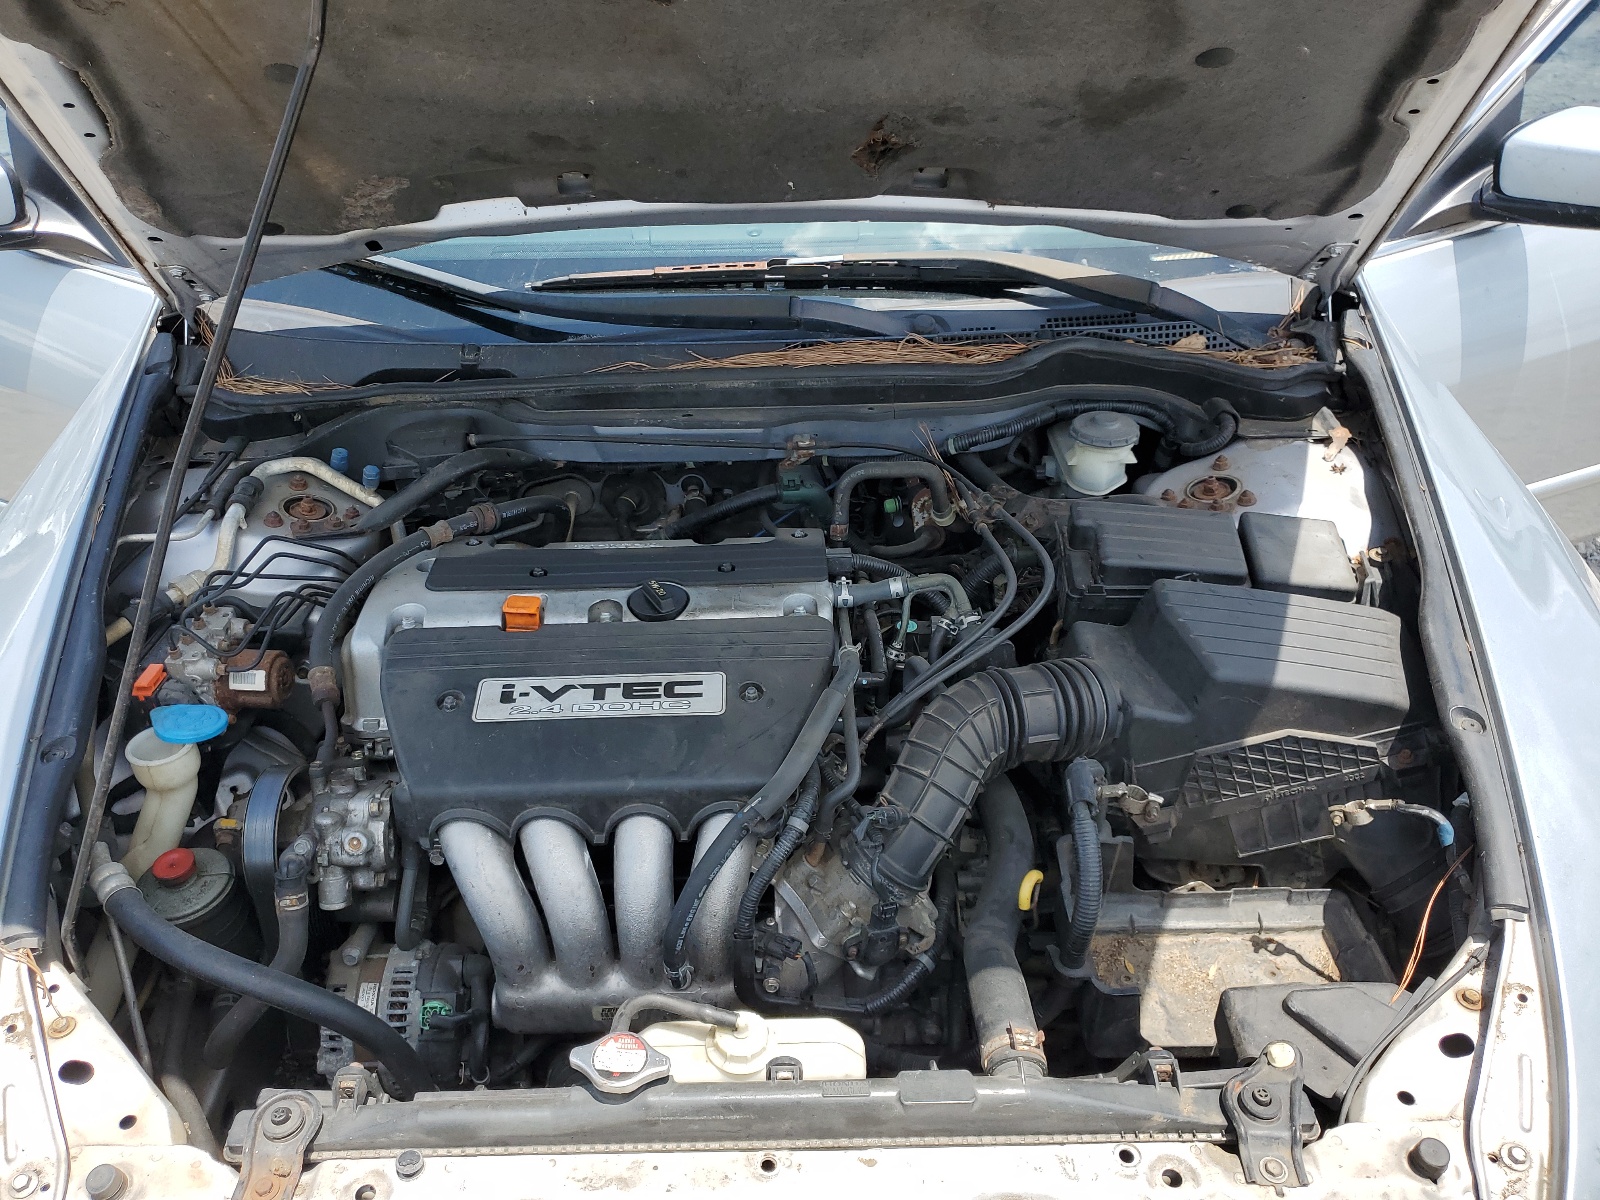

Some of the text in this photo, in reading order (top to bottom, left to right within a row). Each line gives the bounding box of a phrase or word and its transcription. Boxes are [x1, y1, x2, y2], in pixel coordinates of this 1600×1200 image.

[648, 580, 667, 596] 5W-20
[499, 680, 704, 704] i-VTEC
[508, 700, 692, 716] 2.4 DOHC
